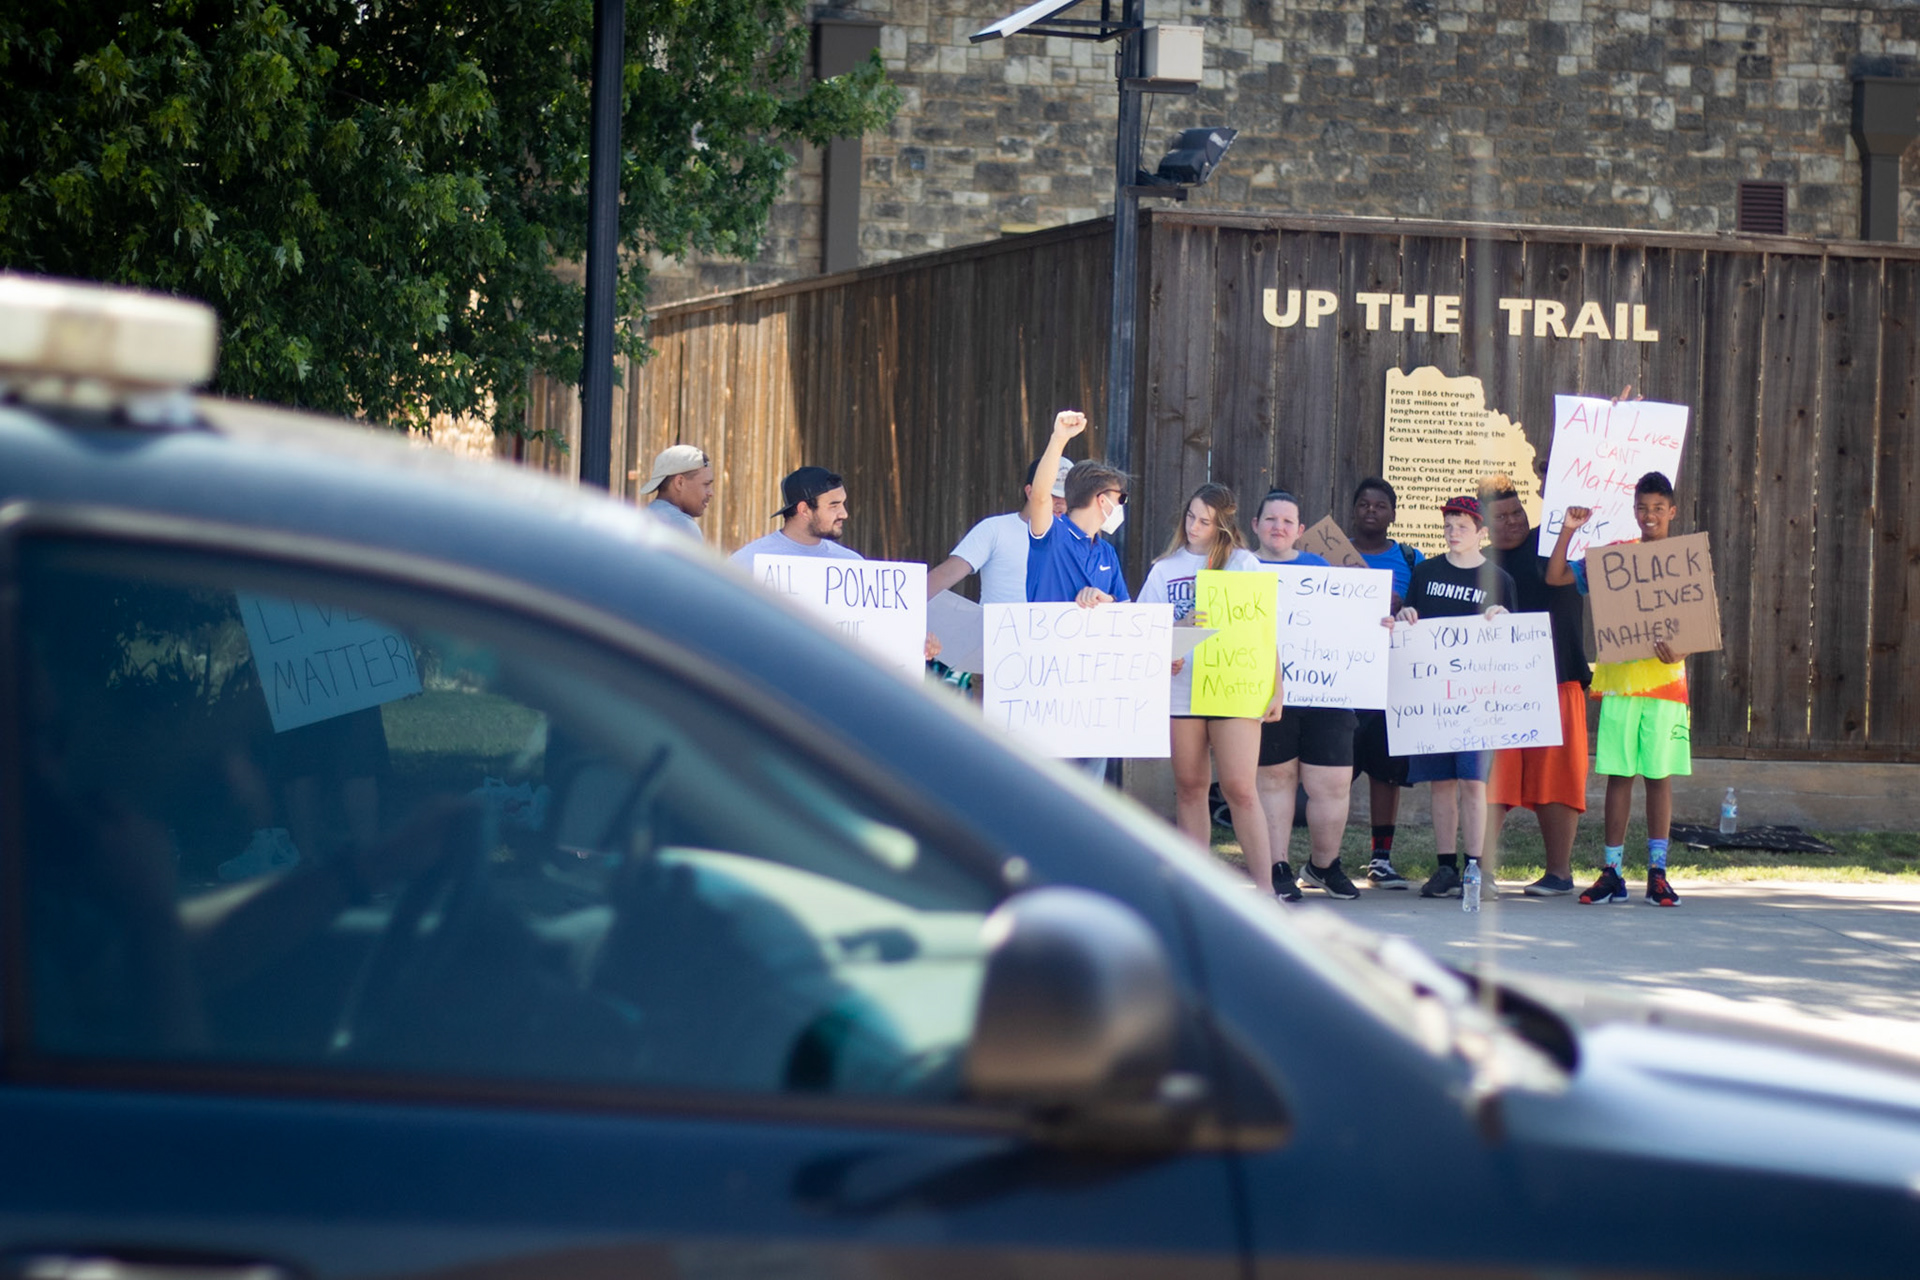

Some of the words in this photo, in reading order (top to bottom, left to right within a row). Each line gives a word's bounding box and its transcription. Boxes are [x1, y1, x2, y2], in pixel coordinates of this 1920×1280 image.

[1263, 288, 1338, 328] UP
[1356, 292, 1460, 333] THE
[1499, 298, 1659, 342] TRAIL
[1414, 399, 1448, 407] millions
[1417, 389, 1438, 397] 1866
[1440, 391, 1475, 400] through
[1390, 407, 1430, 416] longhorn
[1448, 419, 1473, 427] Texas
[1389, 426, 1421, 434] Kansas
[1423, 428, 1463, 436] railheads
[1466, 430, 1489, 438] along
[1491, 430, 1506, 438] the
[1563, 403, 1611, 438] All
[1628, 410, 1680, 449] Lives
[1416, 436, 1452, 445] Western
[1454, 438, 1477, 446] Trail.
[1388, 465, 1417, 473] Doan's
[1419, 466, 1455, 475] Crossing
[1389, 456, 1409, 464] They
[1388, 474, 1423, 483] through
[1442, 476, 1466, 484] Greer
[1406, 485, 1452, 493] comprised
[1562, 458, 1637, 496] Matte
[1405, 494, 1433, 502] Greer,
[1602, 547, 1701, 591] BLACK
[825, 565, 908, 610] POWER
[1295, 573, 1379, 599] Silence
[1635, 583, 1704, 611] LIVES
[1208, 586, 1267, 628] Black
[992, 607, 1168, 647] ABOLISH
[1389, 629, 1412, 649] IF
[1429, 626, 1469, 650] YOU
[1476, 627, 1502, 644] ARE
[1511, 622, 1553, 644] Neutral
[1203, 637, 1257, 669] Lives
[1299, 637, 1339, 661] than
[1346, 650, 1375, 670] you
[274, 634, 416, 715] MATTER!
[993, 652, 1163, 690] QUALIFIED
[1282, 661, 1338, 687] Know
[1409, 662, 1438, 679] In
[1449, 656, 1519, 673] Situations
[1525, 654, 1541, 670] of
[1203, 674, 1264, 699] Matter
[1441, 679, 1521, 704] Injustice
[999, 697, 1149, 733] IMMUNITY
[1432, 702, 1471, 717] Have
[1484, 700, 1541, 713] Chosen
[1436, 715, 1461, 729] the
[1416, 741, 1437, 754] the
[1449, 729, 1539, 751] OPPRESSOR
